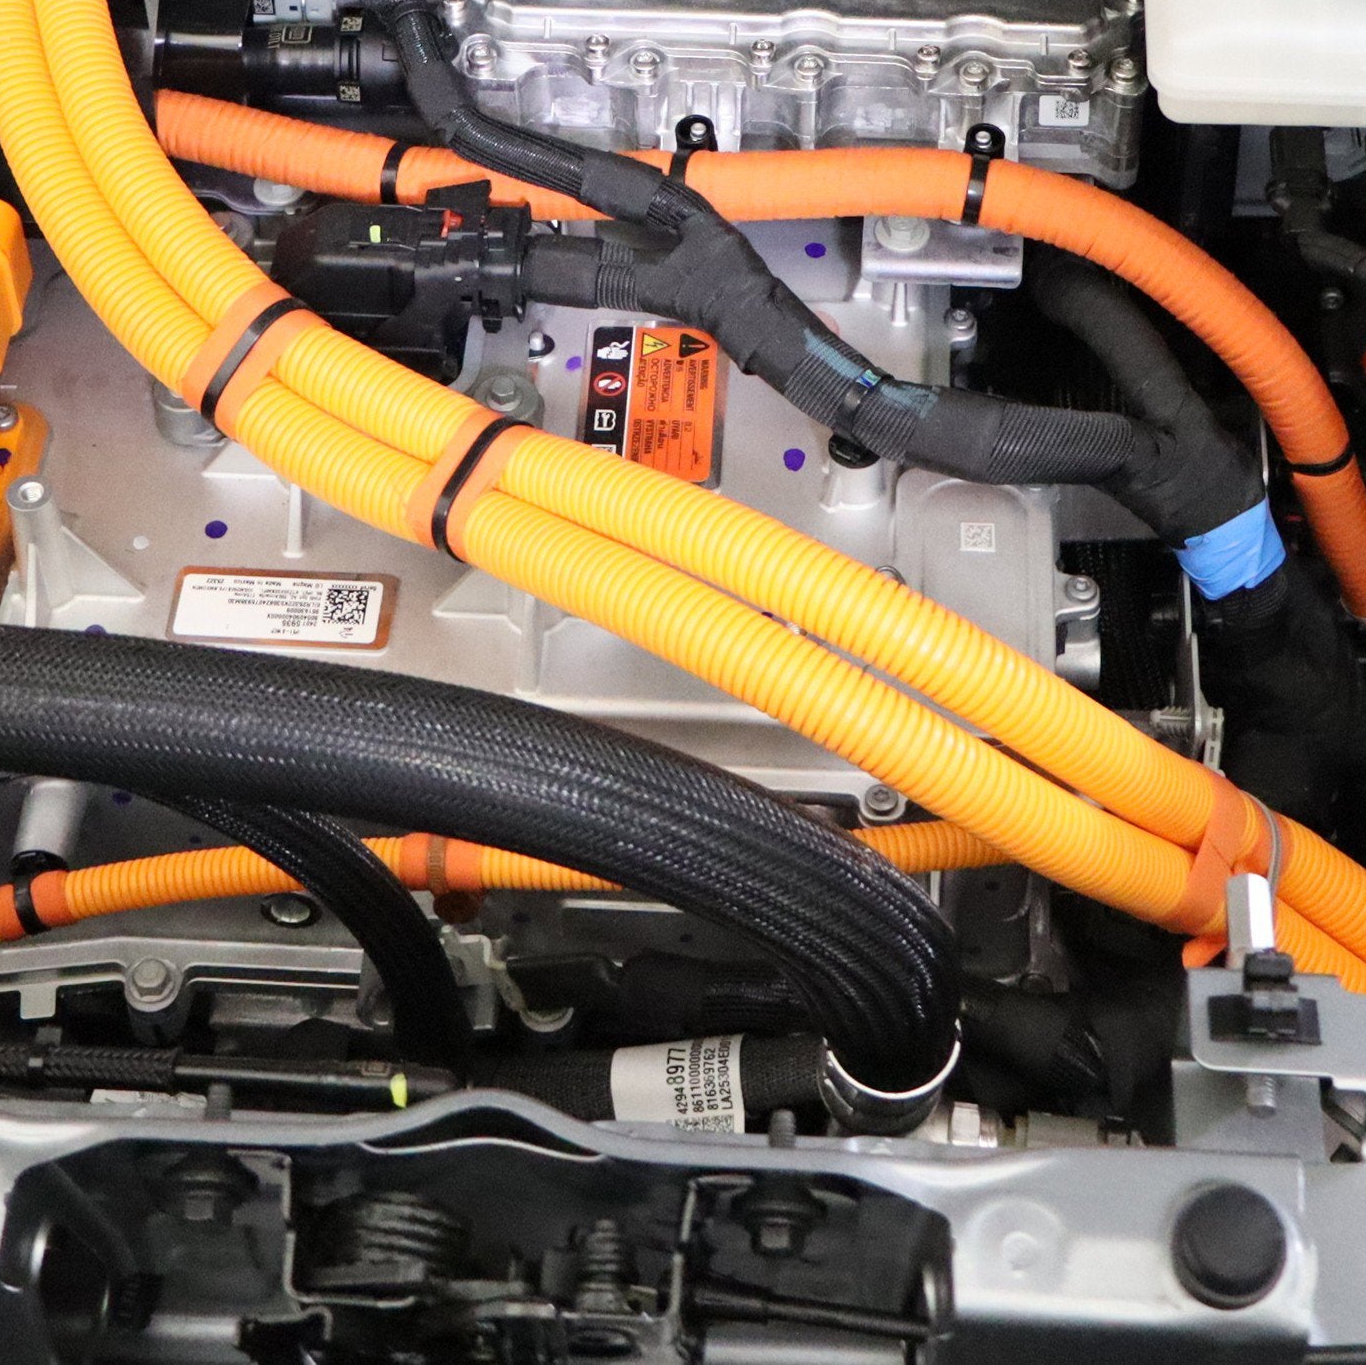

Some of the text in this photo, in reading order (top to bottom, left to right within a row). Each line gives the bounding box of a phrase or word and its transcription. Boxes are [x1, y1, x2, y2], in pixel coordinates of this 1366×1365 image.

[636, 358, 648, 387] ATENÇÃO
[647, 358, 659, 412] ОСТОРОЖНО
[660, 359, 671, 403] ADVERTENCIA
[686, 360, 696, 411] AVERTISSEMENT
[699, 360, 709, 389] WARNING
